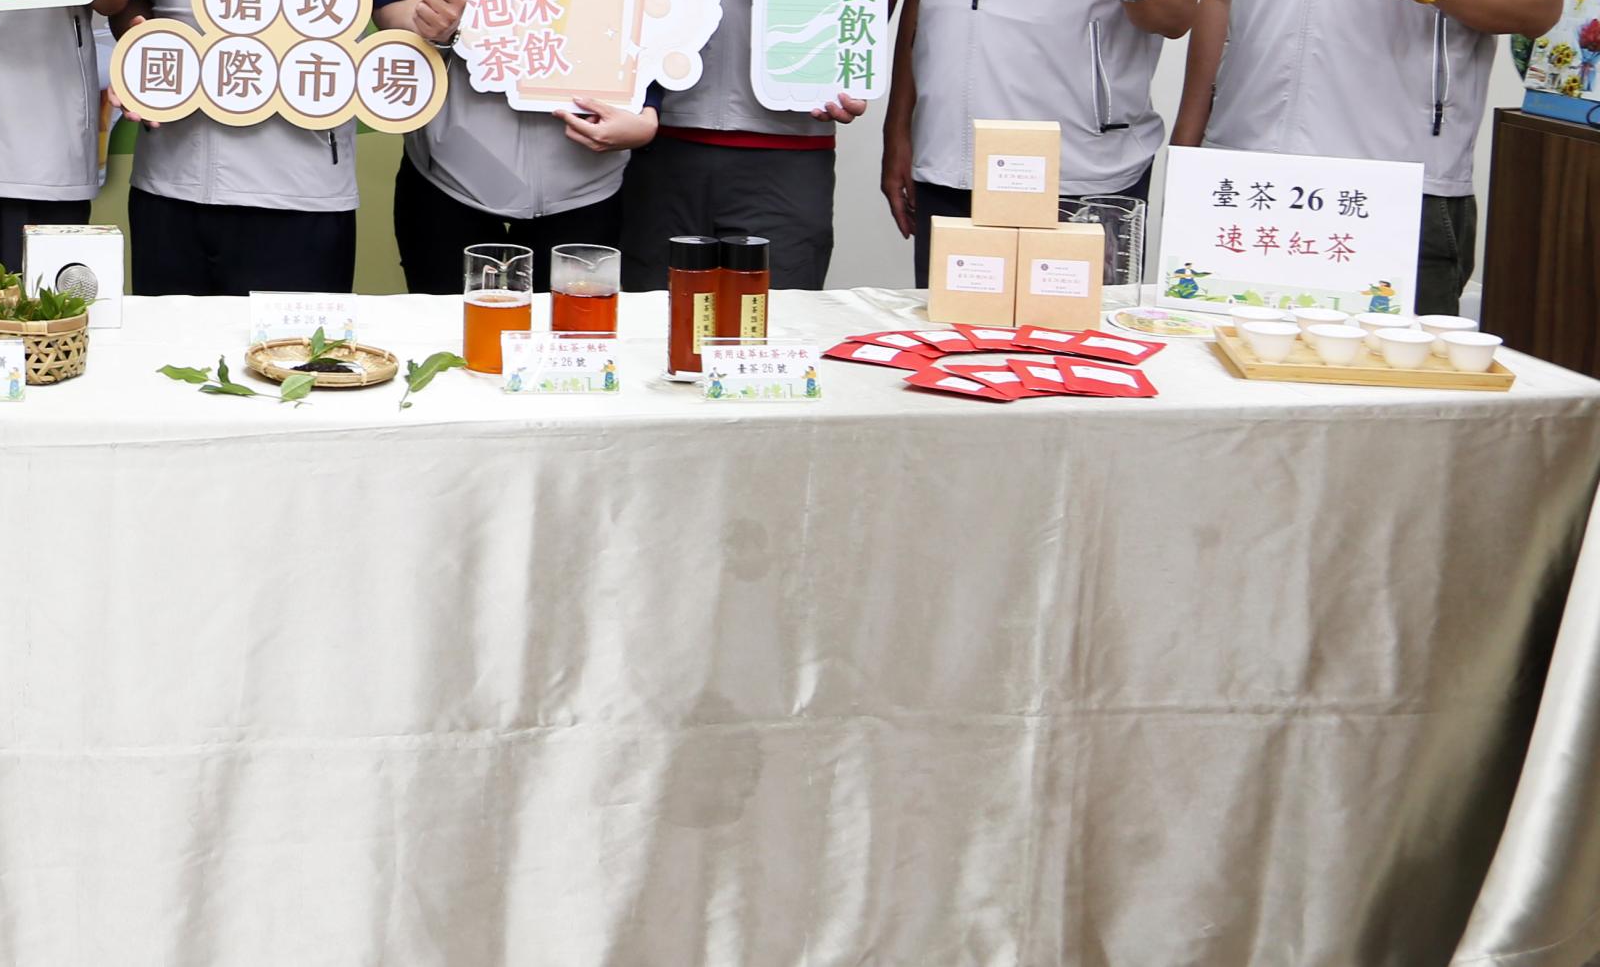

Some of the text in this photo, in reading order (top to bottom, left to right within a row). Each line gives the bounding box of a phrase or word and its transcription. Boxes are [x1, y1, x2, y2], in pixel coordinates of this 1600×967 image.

[139, 46, 419, 107] 國際市場
[474, 31, 570, 82] 茶飲
[1215, 224, 1356, 263] 速萃紅茶
